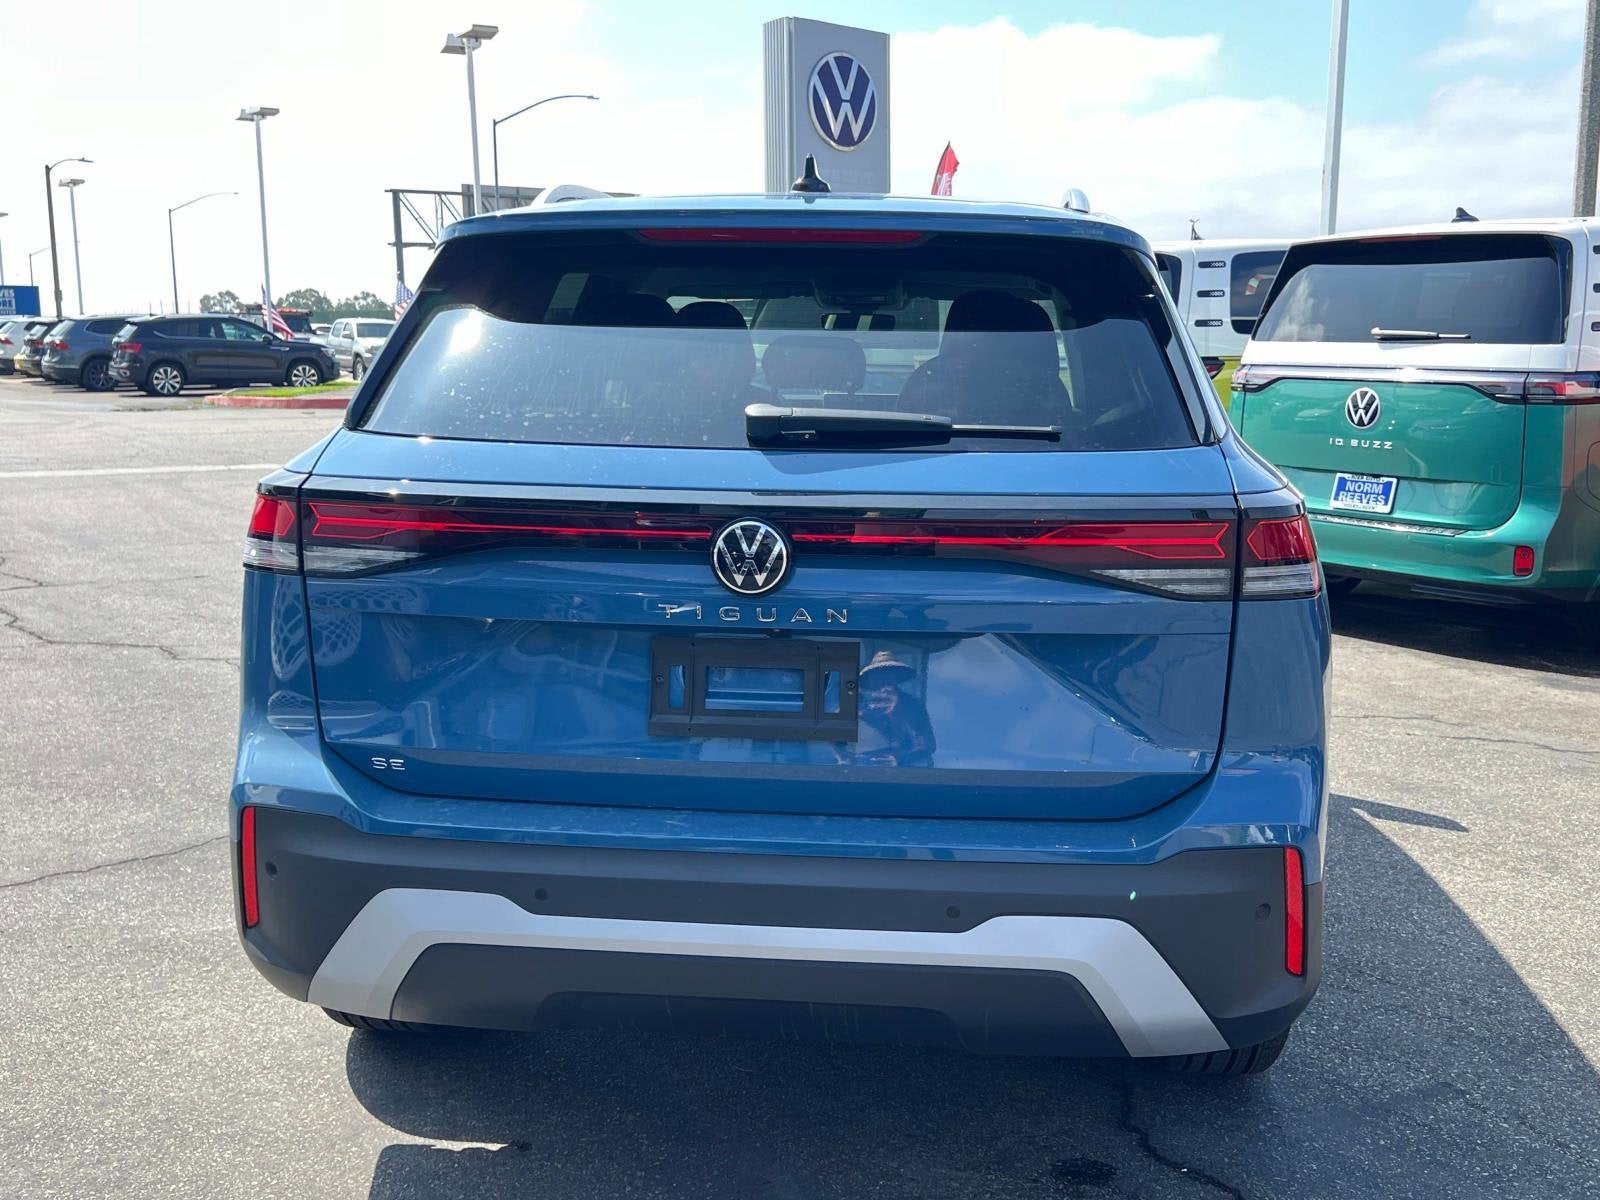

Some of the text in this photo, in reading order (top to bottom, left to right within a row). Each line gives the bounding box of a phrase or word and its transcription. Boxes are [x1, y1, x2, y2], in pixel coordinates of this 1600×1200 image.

[809, 53, 876, 148] VW
[1345, 388, 1380, 428] VW
[1350, 439, 1393, 449] BUZZ
[1345, 481, 1383, 494] NORM
[1338, 491, 1386, 505] REEVES
[714, 521, 787, 593] VW
[658, 603, 848, 623] TIGUAN
[371, 757, 406, 770] SE
